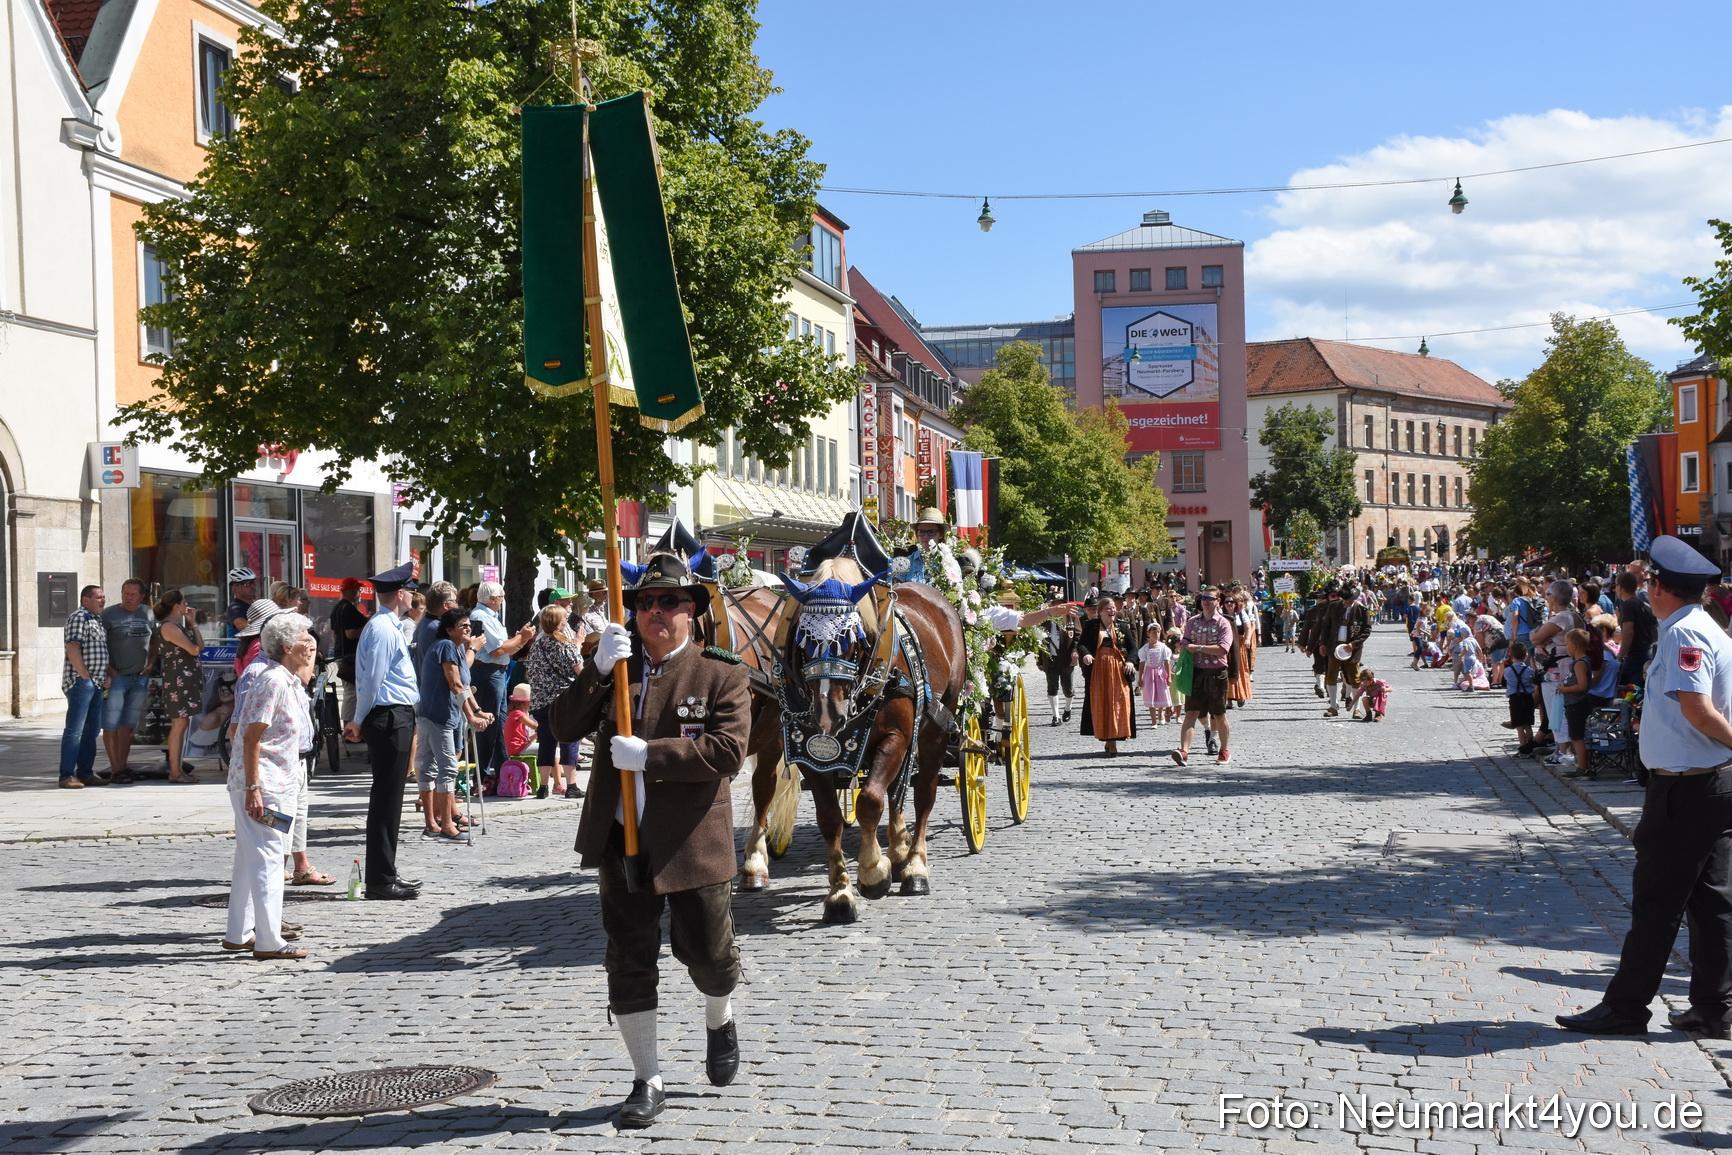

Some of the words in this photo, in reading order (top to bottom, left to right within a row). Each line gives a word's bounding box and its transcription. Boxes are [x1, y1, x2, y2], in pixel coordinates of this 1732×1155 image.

[1126, 414, 1208, 429] usgezeichnet!
[864, 384, 874, 494] BÄCKEREI
[1168, 504, 1208, 515] rkasse
[304, 553, 314, 569] LE
